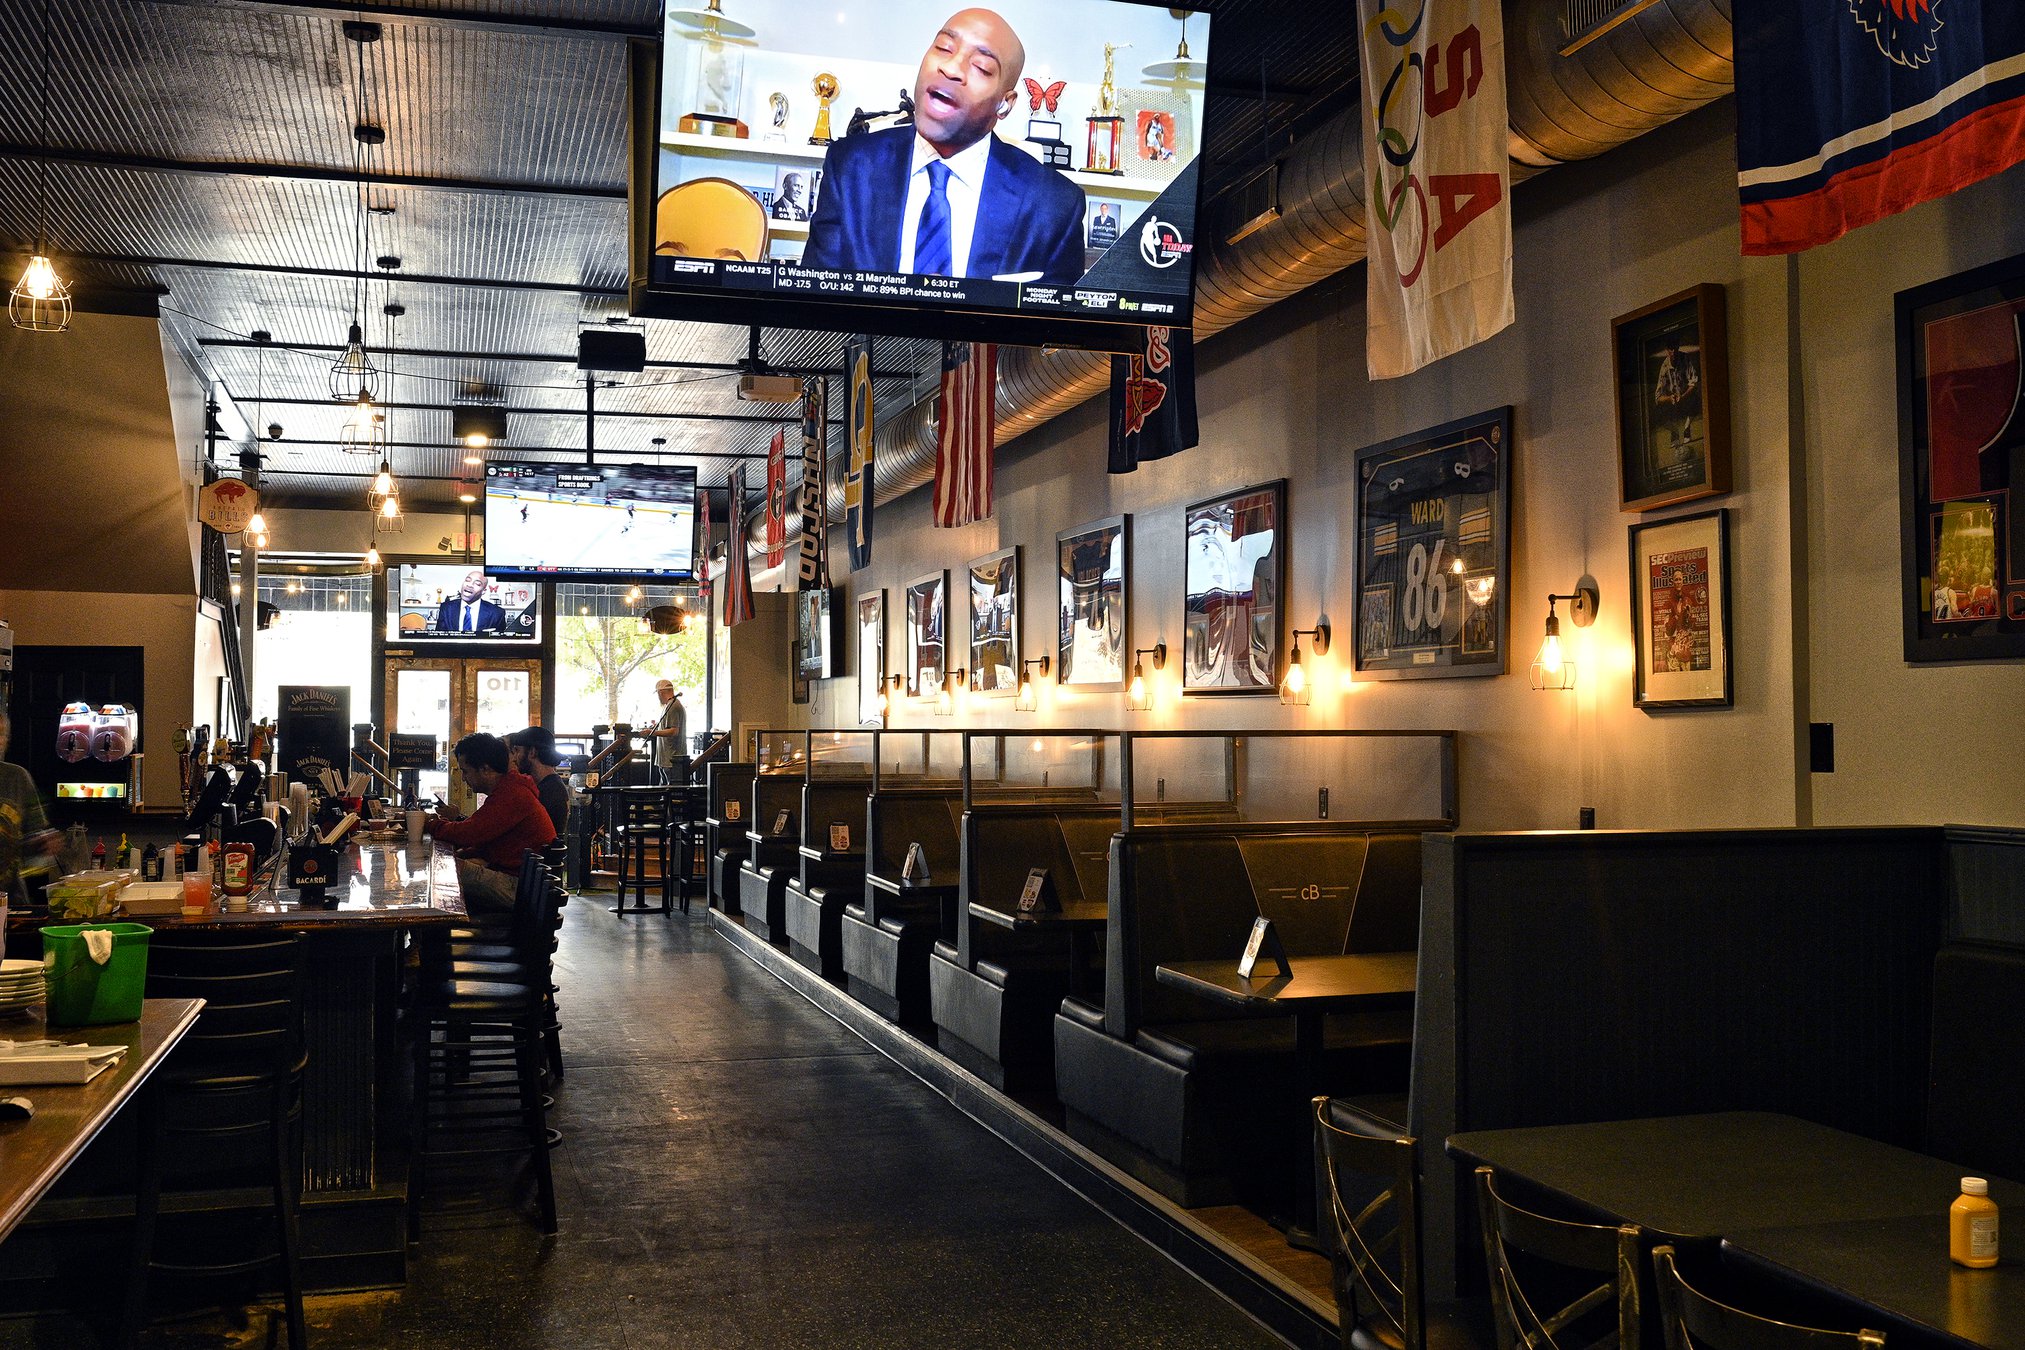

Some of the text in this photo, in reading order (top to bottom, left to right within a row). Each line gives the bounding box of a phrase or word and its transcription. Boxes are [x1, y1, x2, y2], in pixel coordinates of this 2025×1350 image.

[674, 259, 715, 274] ESPN
[725, 264, 771, 275] NCAAM T25
[778, 267, 907, 285] G Washington vs 21 Maryland
[778, 279, 811, 289] MD -17.5
[820, 281, 854, 292] O/U: 142
[931, 278, 959, 288] 6:30 ET
[862, 285, 966, 300] MD: 89% BPI chance to win
[1026, 287, 1058, 295] MONDAY
[1076, 292, 1117, 301] PEYTON
[1022, 296, 1061, 305] FOOTBALL
[1411, 497, 1445, 526] WARD
[1403, 538, 1447, 632] 86
[1652, 569, 1708, 590] Illusated
[291, 688, 337, 706] JACK DANIEL'S
[295, 874, 327, 885] BACARDÍ
[1301, 884, 1320, 901] cB
